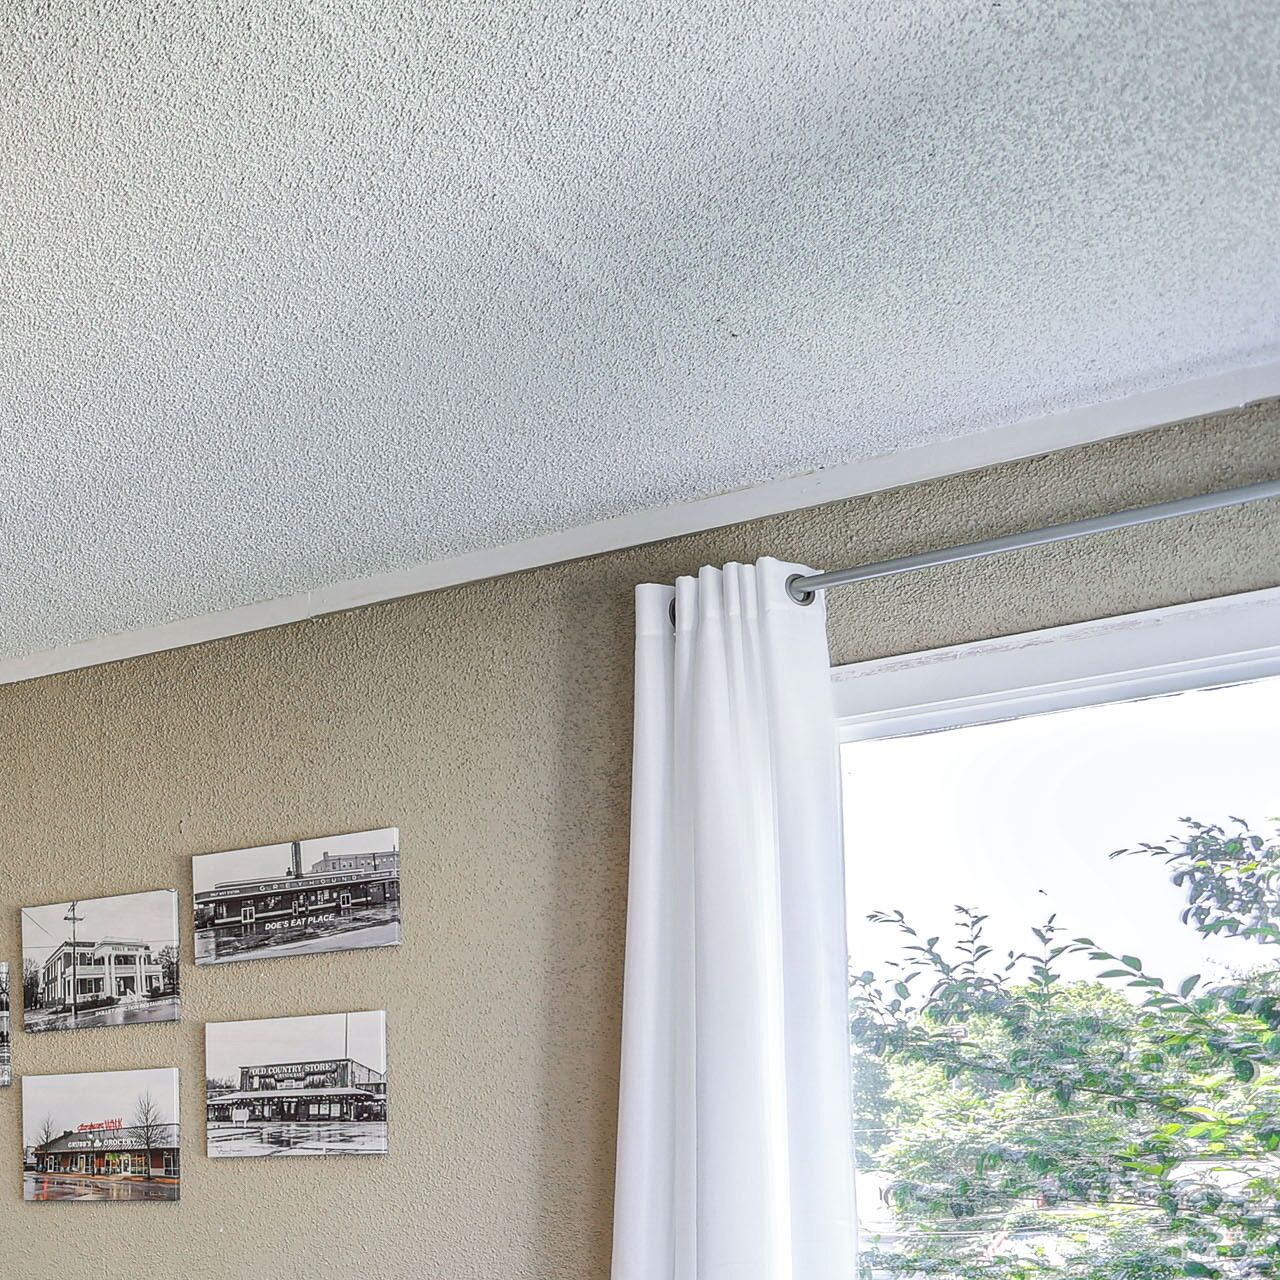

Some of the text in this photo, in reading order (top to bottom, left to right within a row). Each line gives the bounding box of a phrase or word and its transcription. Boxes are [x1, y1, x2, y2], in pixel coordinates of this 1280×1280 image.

[259, 875, 357, 892] GREYHOUND
[265, 913, 336, 931] DOE'S EAT PLACE
[268, 1064, 303, 1074] COUNTRY
[304, 1062, 332, 1072] STORE
